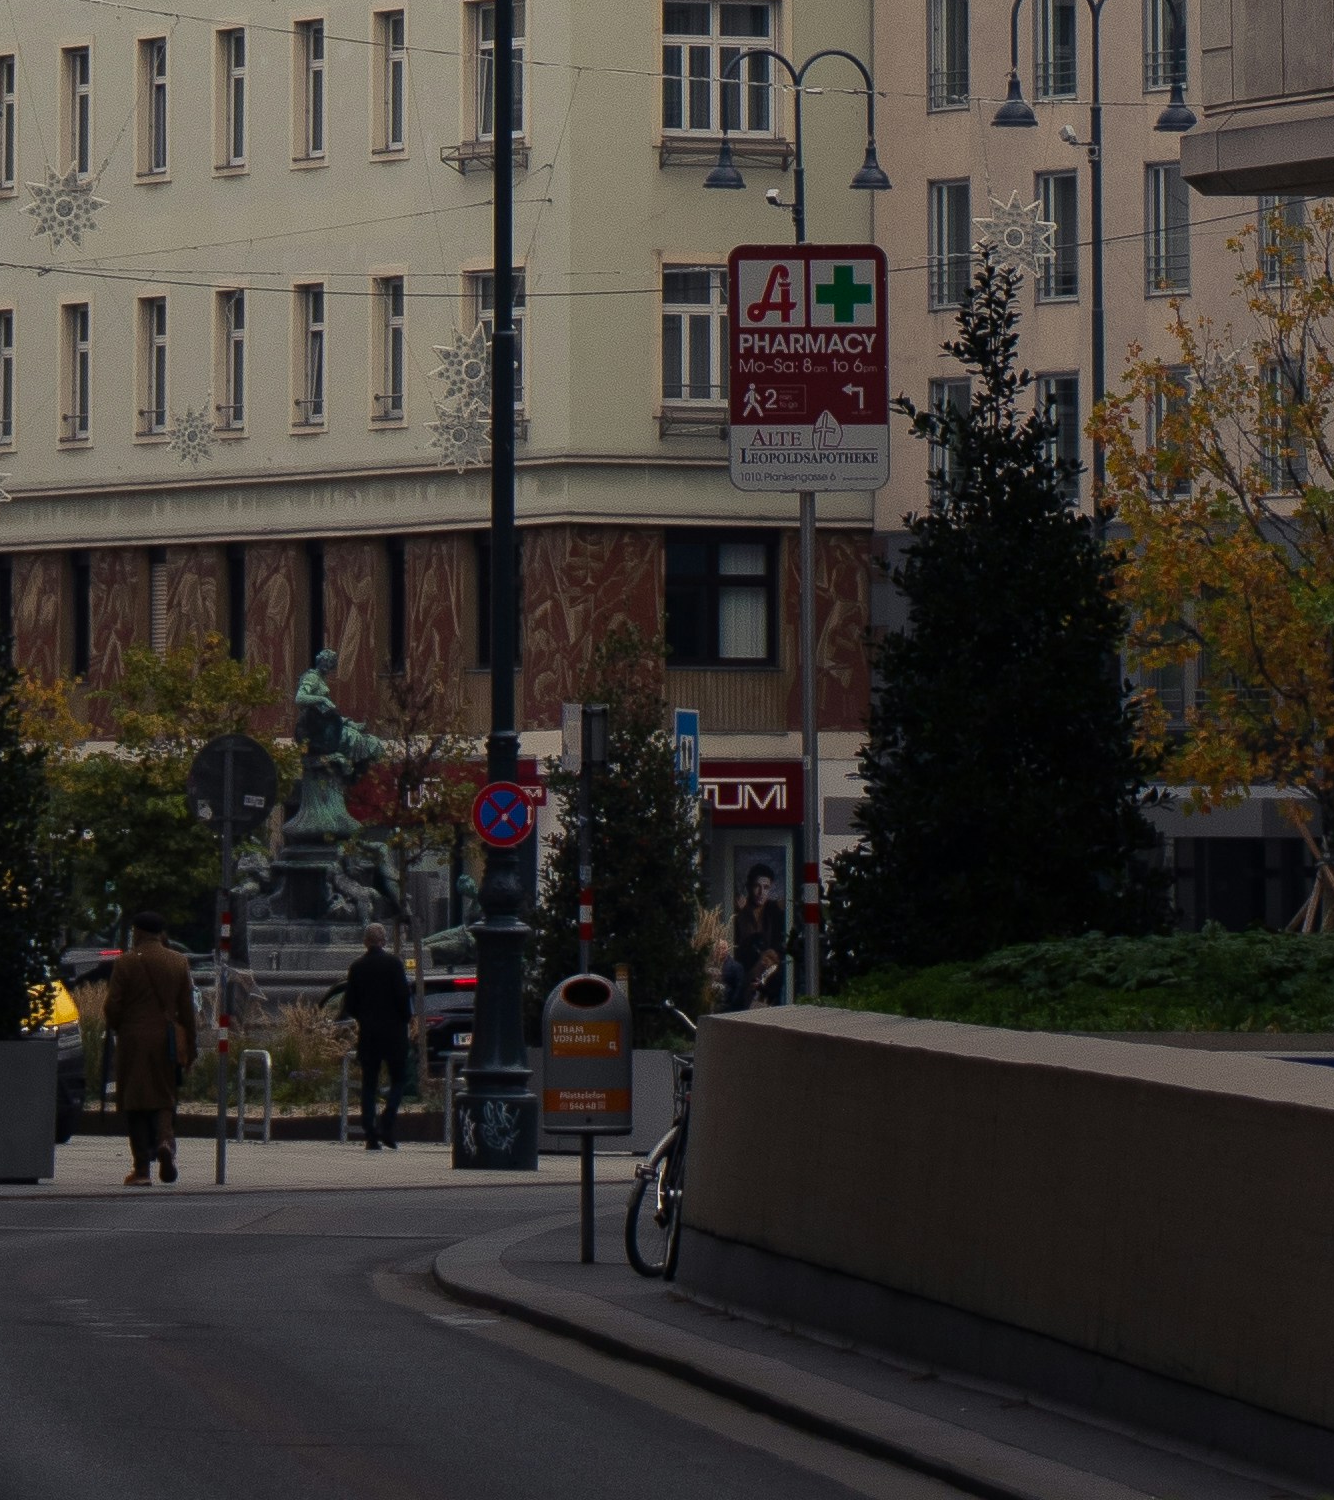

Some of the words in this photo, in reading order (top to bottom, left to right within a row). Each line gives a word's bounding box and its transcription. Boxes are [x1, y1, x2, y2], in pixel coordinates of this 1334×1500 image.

[739, 333, 877, 354] PHARMACY
[832, 358, 850, 373] to
[765, 389, 778, 409] 2
[751, 429, 802, 446] ALTE
[740, 448, 879, 465] LEOPOLDSAPOTHEKE
[698, 777, 787, 810] TUMI
